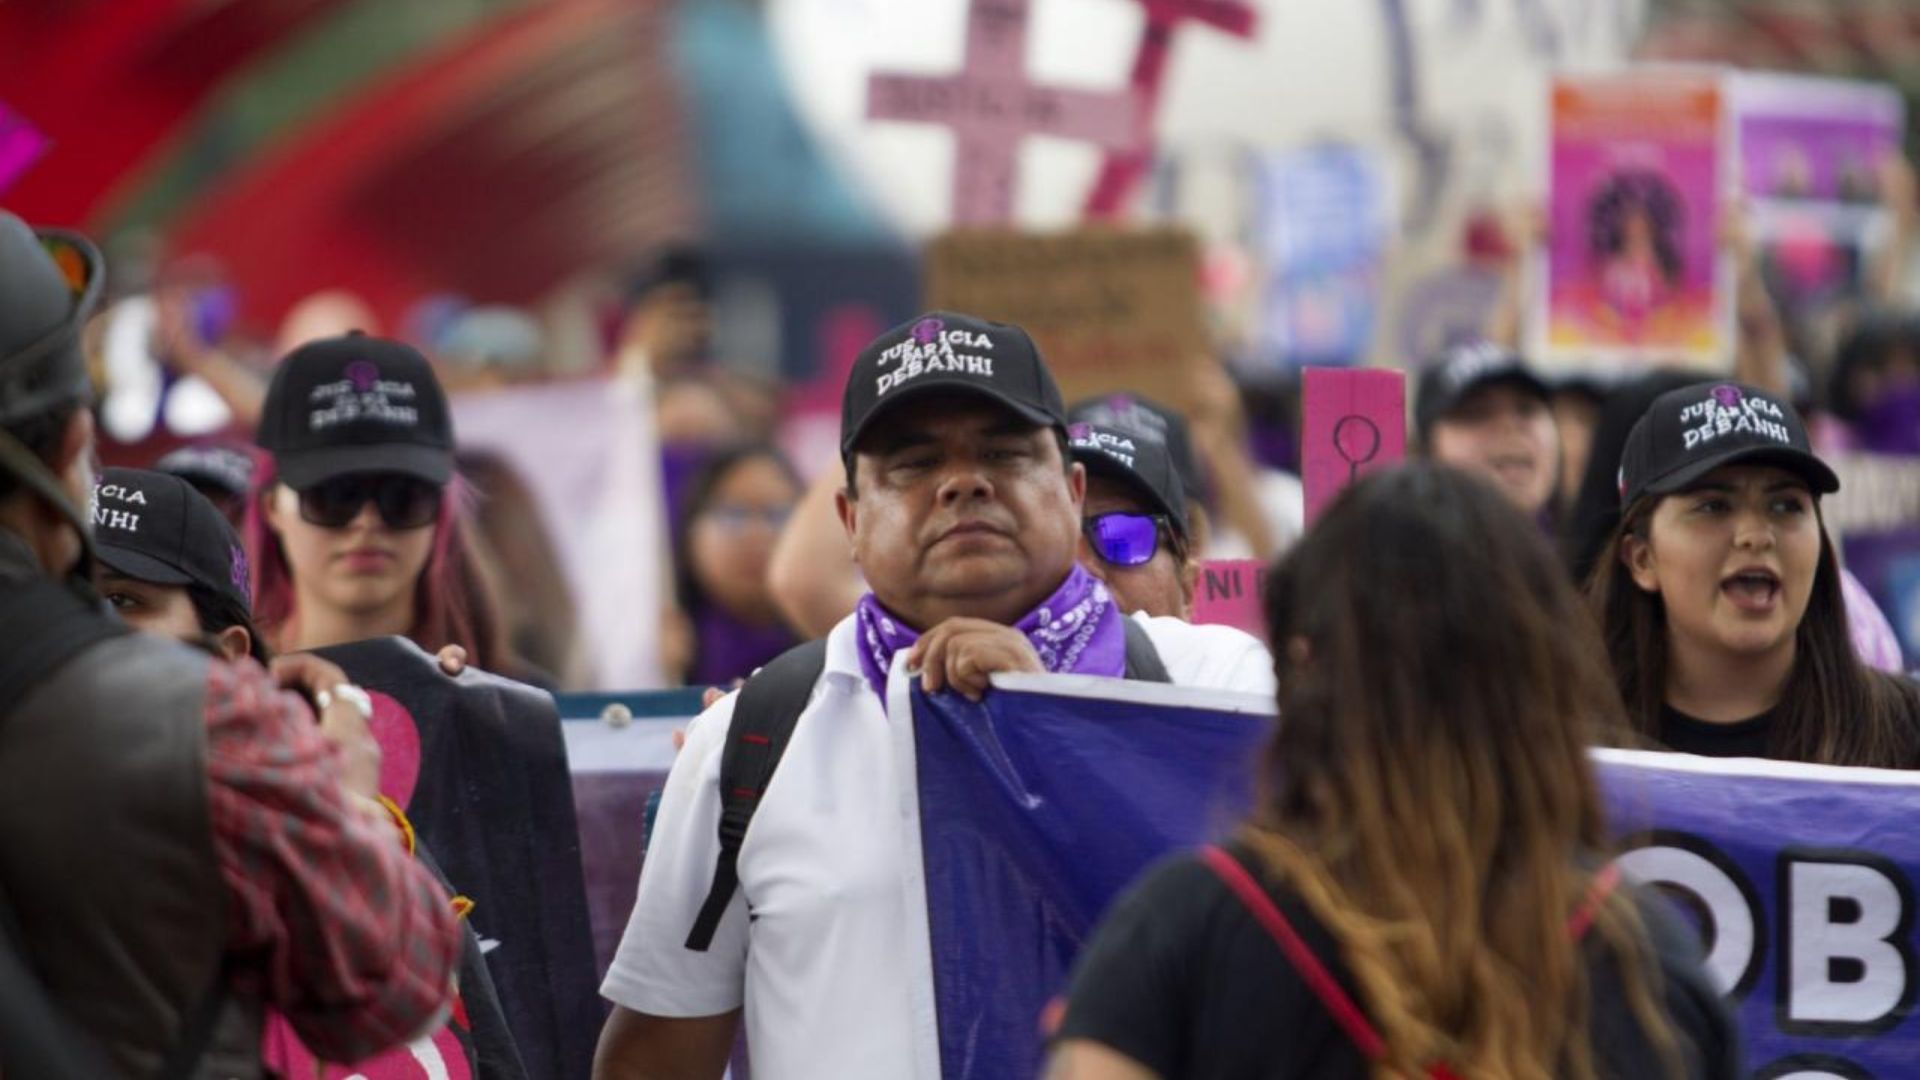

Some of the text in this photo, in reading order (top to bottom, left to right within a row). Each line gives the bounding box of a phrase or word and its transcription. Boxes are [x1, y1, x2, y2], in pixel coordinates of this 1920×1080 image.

[877, 328, 994, 367] JUSICIA
[876, 354, 994, 396] DEBANHI
[1680, 396, 1784, 422] JUSICIA
[1682, 414, 1790, 451] DEBANHI
[1204, 569, 1244, 602] NI
